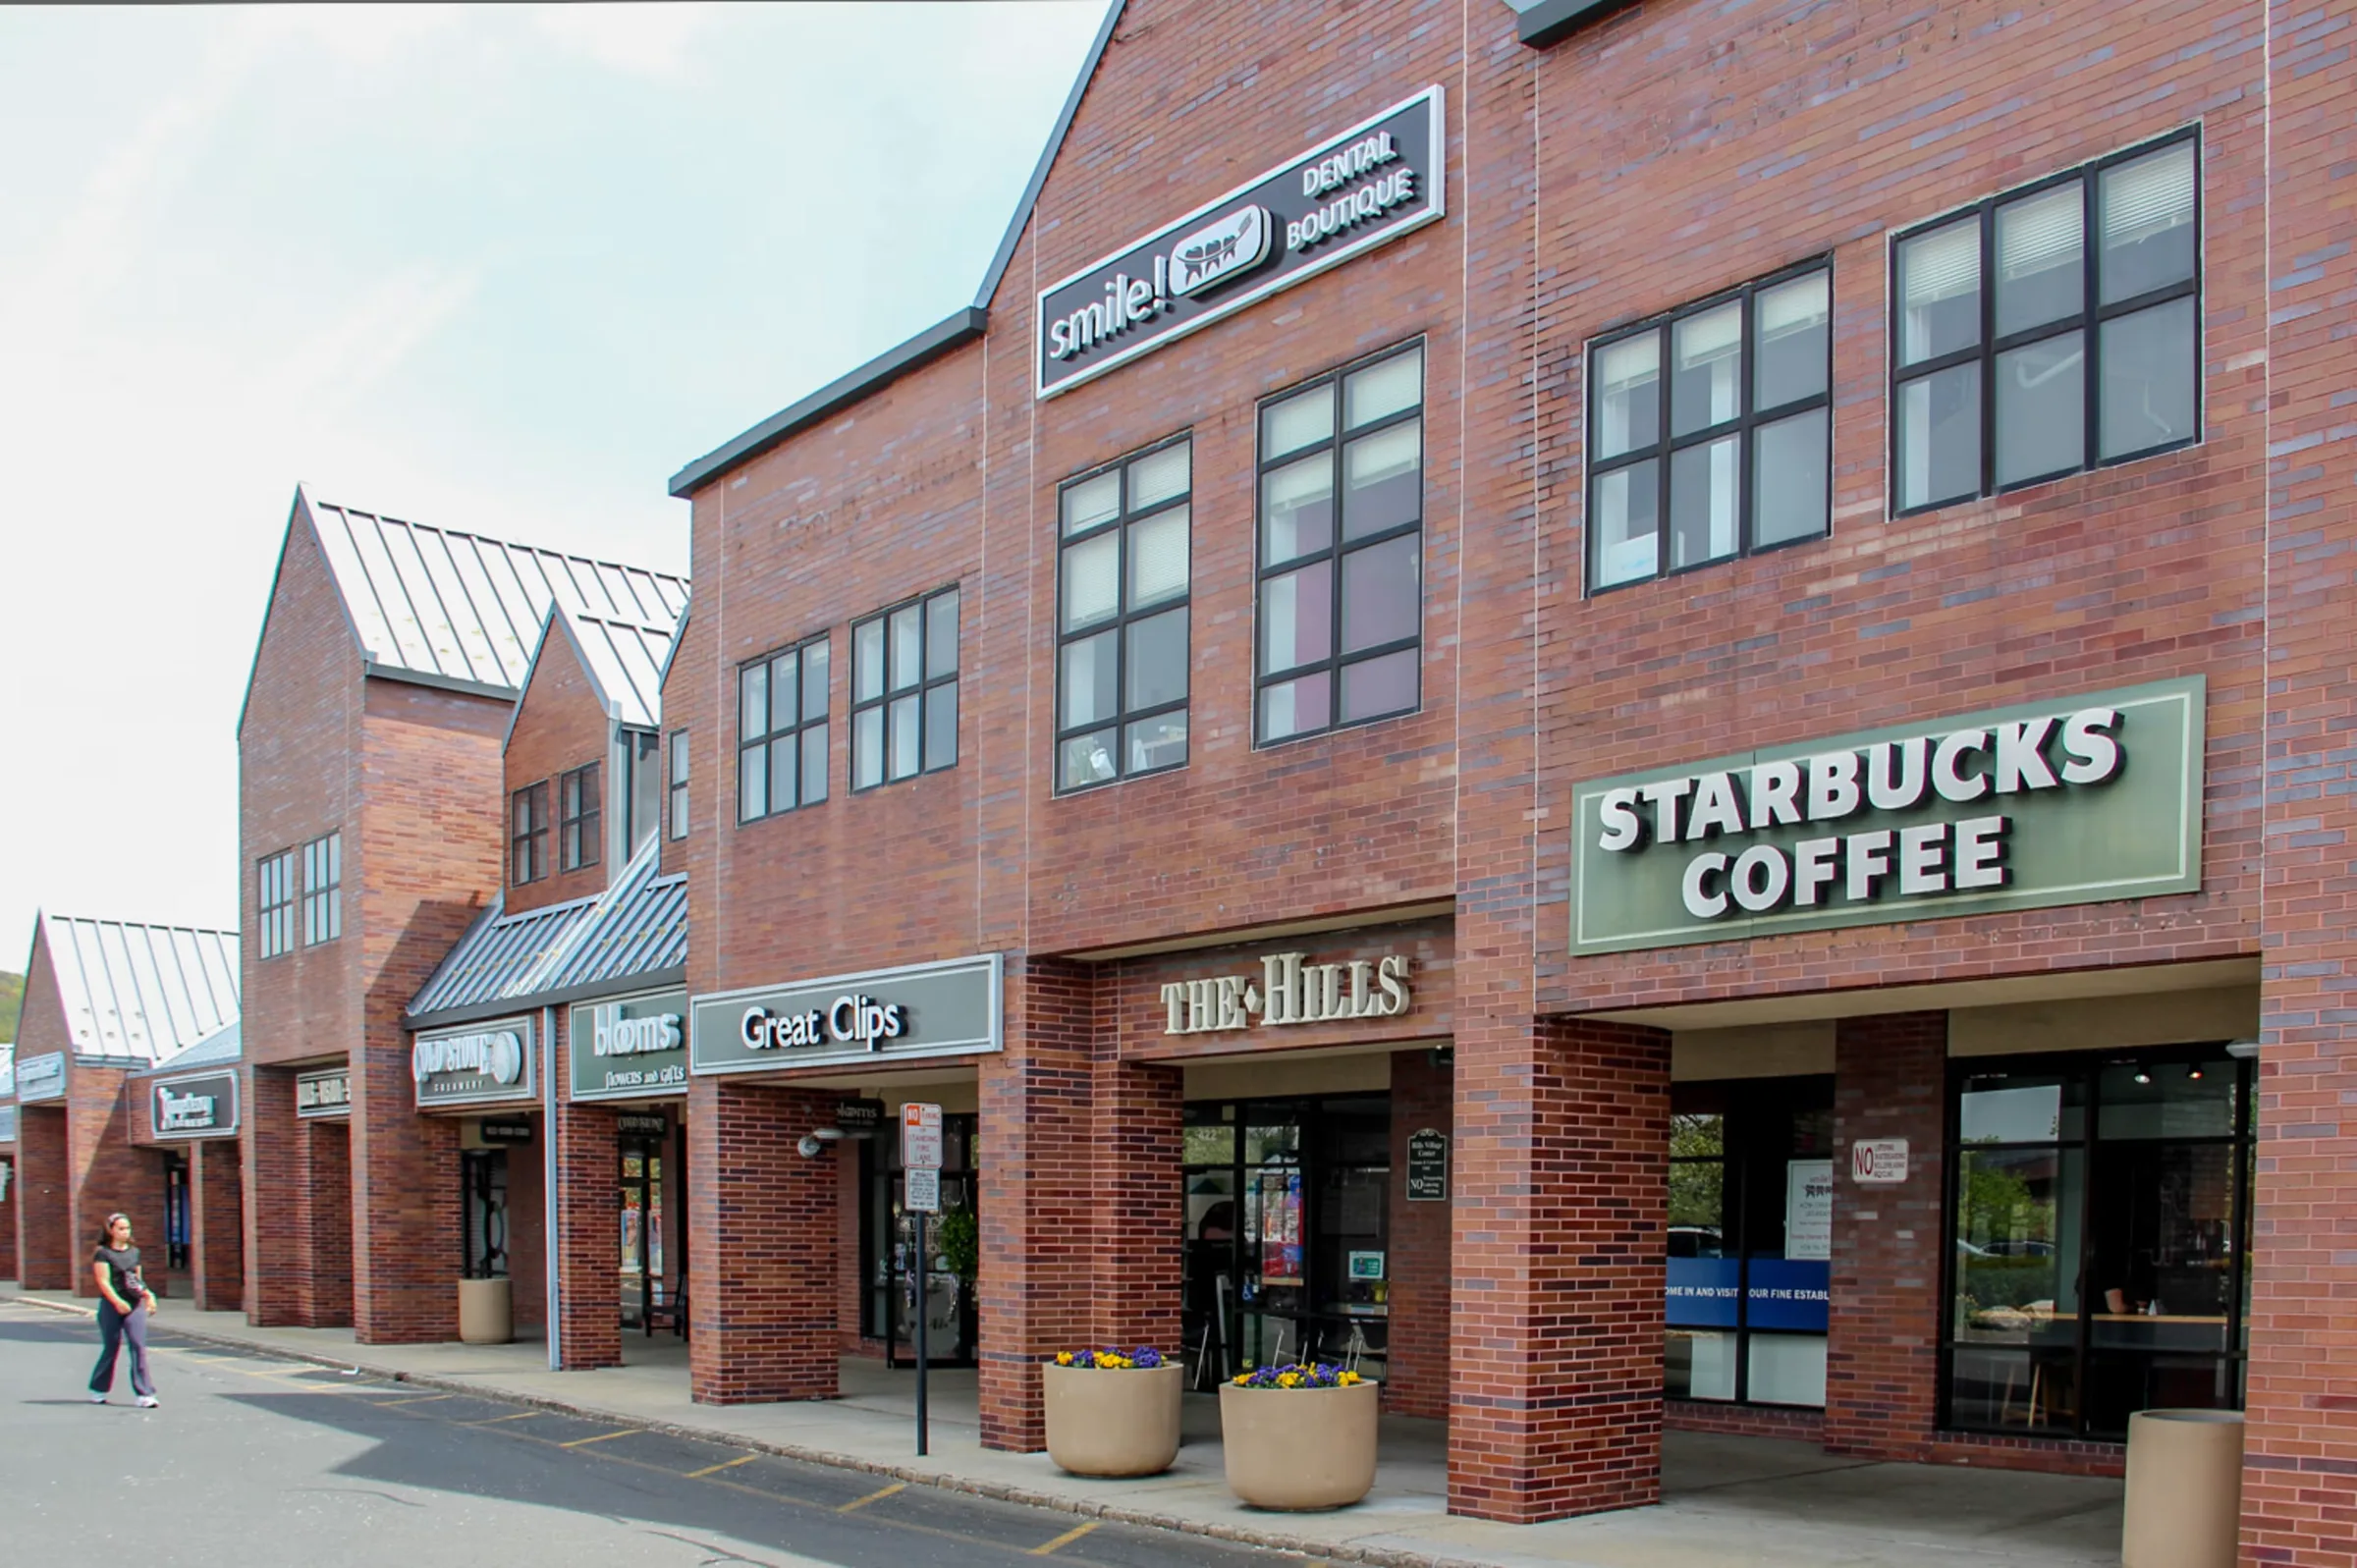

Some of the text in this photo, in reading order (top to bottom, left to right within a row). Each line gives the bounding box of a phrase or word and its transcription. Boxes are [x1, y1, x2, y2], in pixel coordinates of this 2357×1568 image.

[1303, 131, 1397, 196] DENTAL
[1287, 168, 1414, 250] BOUTIQUE
[1050, 254, 1170, 359] smile!
[1599, 708, 2123, 851] STARBUCKS
[1682, 815, 2009, 918] COFFEE
[741, 996, 902, 1051] Great Clips
[1161, 951, 1411, 1035] THE HILLS
[594, 1004, 682, 1056] blooms
[1410, 1177, 1423, 1190] NO
[1855, 1146, 1874, 1176] NO
[1684, 1287, 1694, 1296] IN
[1696, 1287, 1715, 1297] AND
[1716, 1287, 1739, 1298] VISIT
[1748, 1288, 1769, 1298] OUR
[1771, 1289, 1792, 1299] FINE
